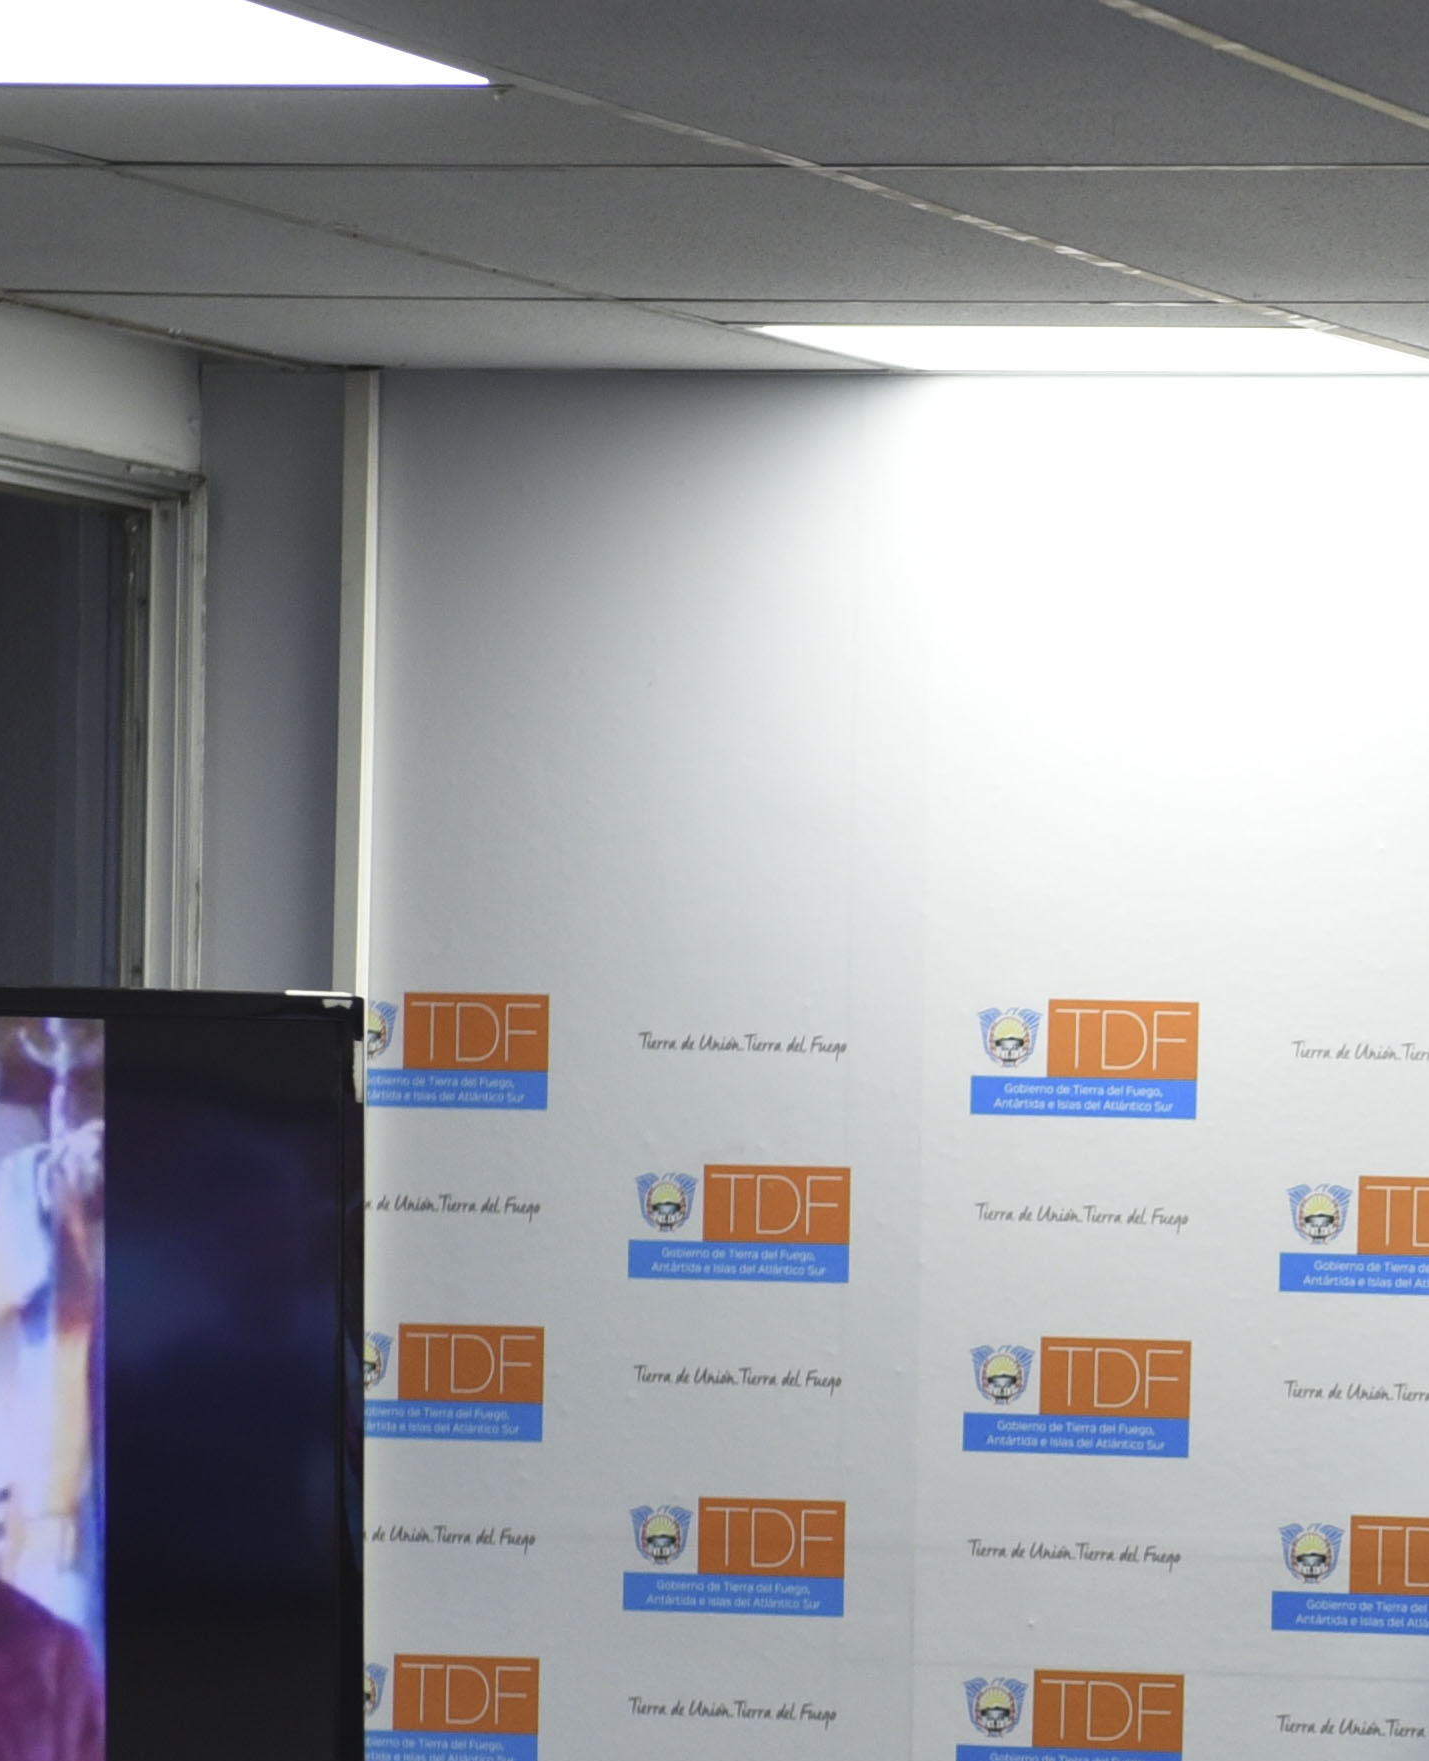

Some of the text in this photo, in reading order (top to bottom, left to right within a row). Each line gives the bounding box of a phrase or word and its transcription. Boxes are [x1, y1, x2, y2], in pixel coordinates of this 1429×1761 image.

[411, 1000, 543, 1063] TDF
[639, 1032, 676, 1049] Tierra
[680, 1035, 694, 1050] de
[743, 1034, 782, 1051] Tierra
[786, 1035, 805, 1053] del
[810, 1036, 847, 1063] Fuego
[1054, 1007, 1193, 1071] TDF
[710, 1172, 844, 1235] TDF
[975, 1202, 1014, 1220] Tierra
[1018, 1206, 1032, 1221] de
[1083, 1205, 1122, 1223] Tierra
[1127, 1207, 1146, 1225] del
[1151, 1208, 1189, 1236] Fuego
[406, 1332, 538, 1394] TDF
[1047, 1345, 1185, 1410] TDF
[1284, 1380, 1323, 1398] Tierra
[1327, 1383, 1342, 1399] de
[705, 1506, 839, 1569] TDF
[400, 1662, 533, 1725] TDF
[1040, 1678, 1178, 1743] TDF
